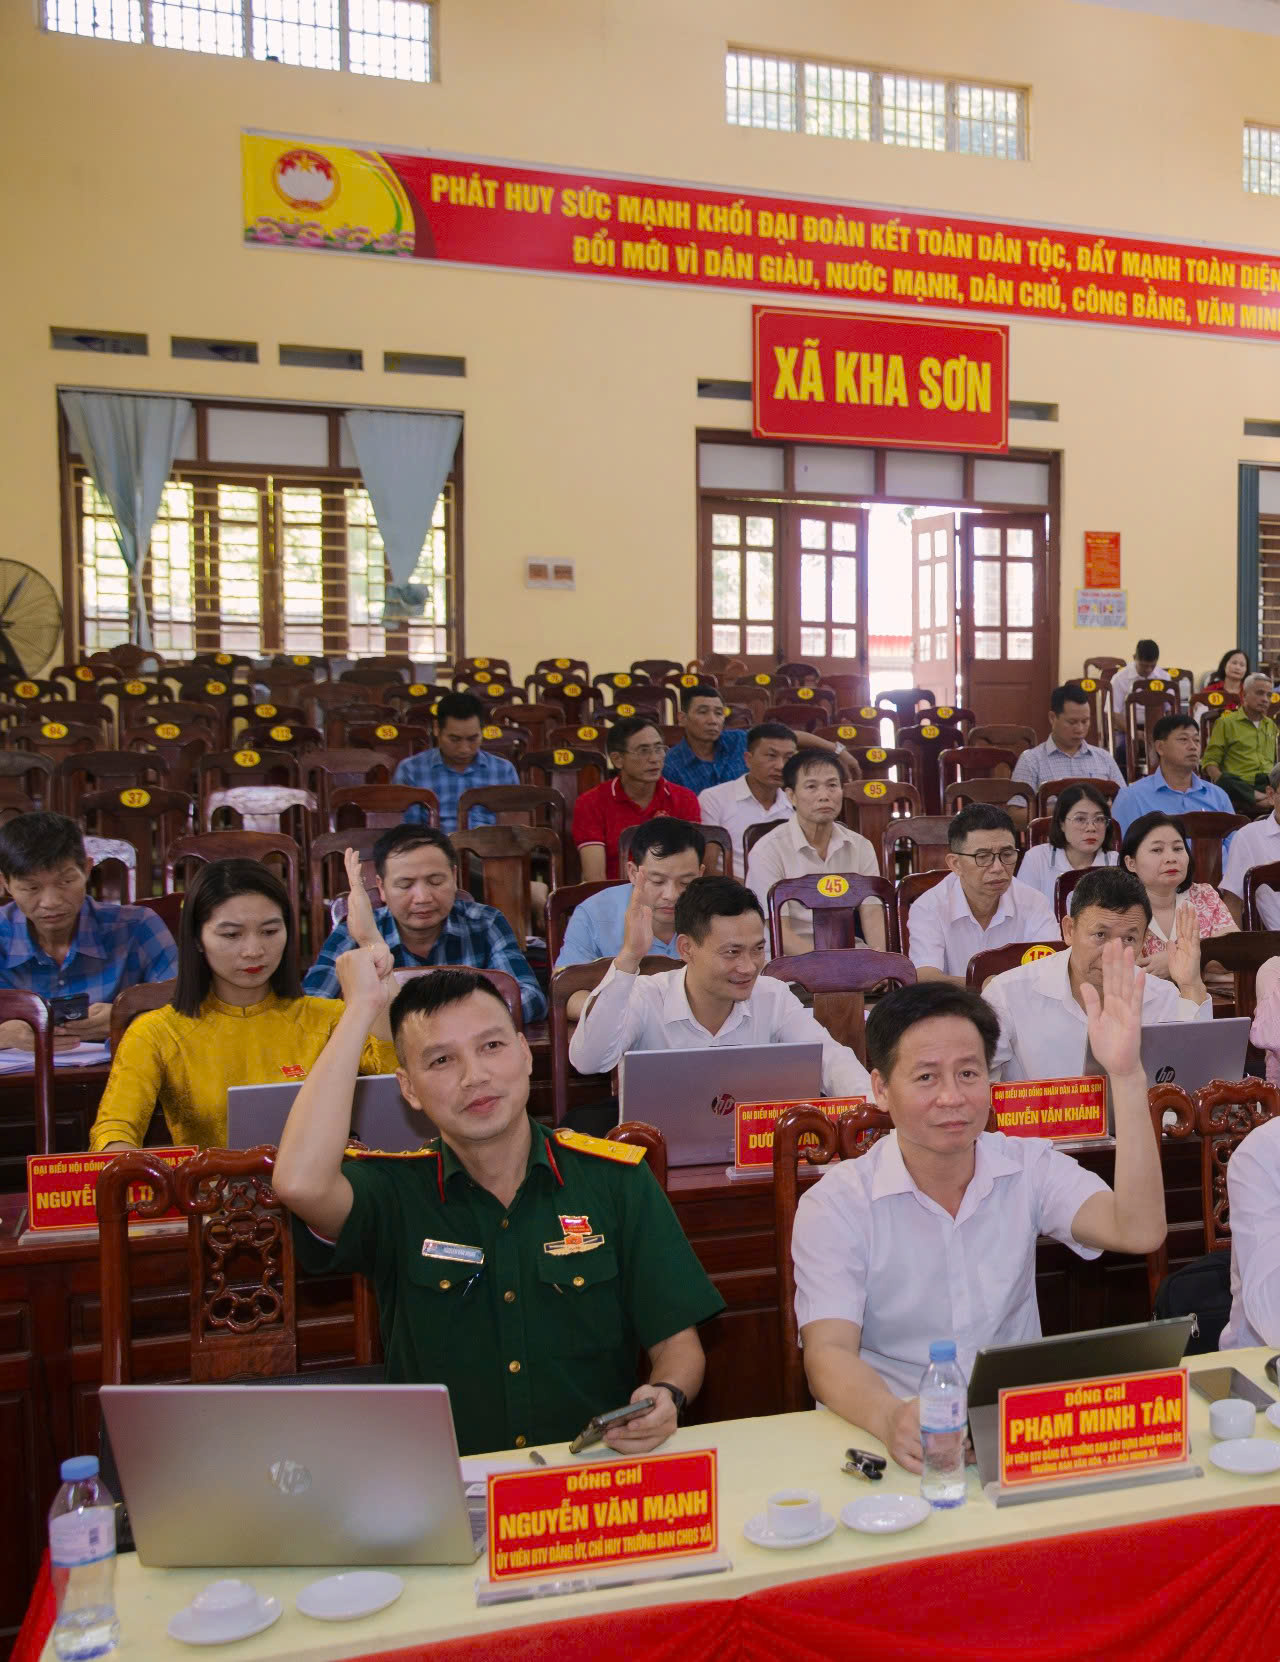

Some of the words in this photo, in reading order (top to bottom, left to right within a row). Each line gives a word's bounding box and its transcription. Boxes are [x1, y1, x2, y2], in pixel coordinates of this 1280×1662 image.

[431, 173, 496, 208] PHÁT
[504, 182, 552, 213] HUY
[561, 188, 611, 220] SỨC
[617, 195, 691, 231] MẠNH
[696, 199, 752, 236] KHỐI
[757, 210, 797, 244] ĐẠI
[802, 215, 864, 248] ĐOÀN
[871, 220, 911, 252] KẾT
[916, 224, 973, 259] TOÀN
[977, 231, 1022, 264] DÂN
[1025, 236, 1072, 277] TỘC,
[1076, 240, 1117, 275] ĐẨY
[1121, 249, 1180, 287] MẠNH
[1184, 256, 1236, 288] TOÀN
[573, 227, 615, 265] ĐỔI
[622, 239, 669, 272] MỚI
[674, 244, 698, 274] VÌ
[704, 247, 752, 280] DÂN
[759, 252, 819, 288] GIÀU,
[825, 260, 887, 293] NƯỚC
[892, 267, 964, 304] MẠNH,
[968, 272, 1014, 304] DÂN
[1018, 277, 1067, 312] CHỦ,
[1071, 282, 1128, 317] CÔNG
[1131, 288, 1192, 323] BẰNG,
[1195, 295, 1234, 327] VĂN
[773, 337, 824, 400] XÃ
[834, 350, 908, 408] KHA
[919, 354, 992, 413] SƠN
[558, 752, 568, 761] 70
[128, 793, 142, 803] 37
[870, 785, 881, 794] 95
[825, 879, 841, 893] 45
[1156, 1066, 1175, 1084] hp
[1070, 1083, 1078, 1094] XÃ
[712, 1093, 735, 1116] hp
[996, 1104, 1039, 1127] NGUYỄN
[1040, 1106, 1062, 1123] VĂN
[1063, 1103, 1100, 1121] KHÁNH
[69, 1162, 82, 1175] HỘI
[1064, 1386, 1101, 1406] ĐỒNG
[1104, 1382, 1125, 1401] CHÍ
[1009, 1412, 1073, 1445] PHẠM
[1079, 1399, 1135, 1434] MINH
[1140, 1395, 1181, 1426] TÂN
[566, 1470, 611, 1491] ĐỒNG
[615, 1463, 642, 1485] CHÍ
[498, 1498, 588, 1540] NGUYỄN
[593, 1495, 638, 1527] VĂN
[642, 1489, 707, 1523] MẠNH
